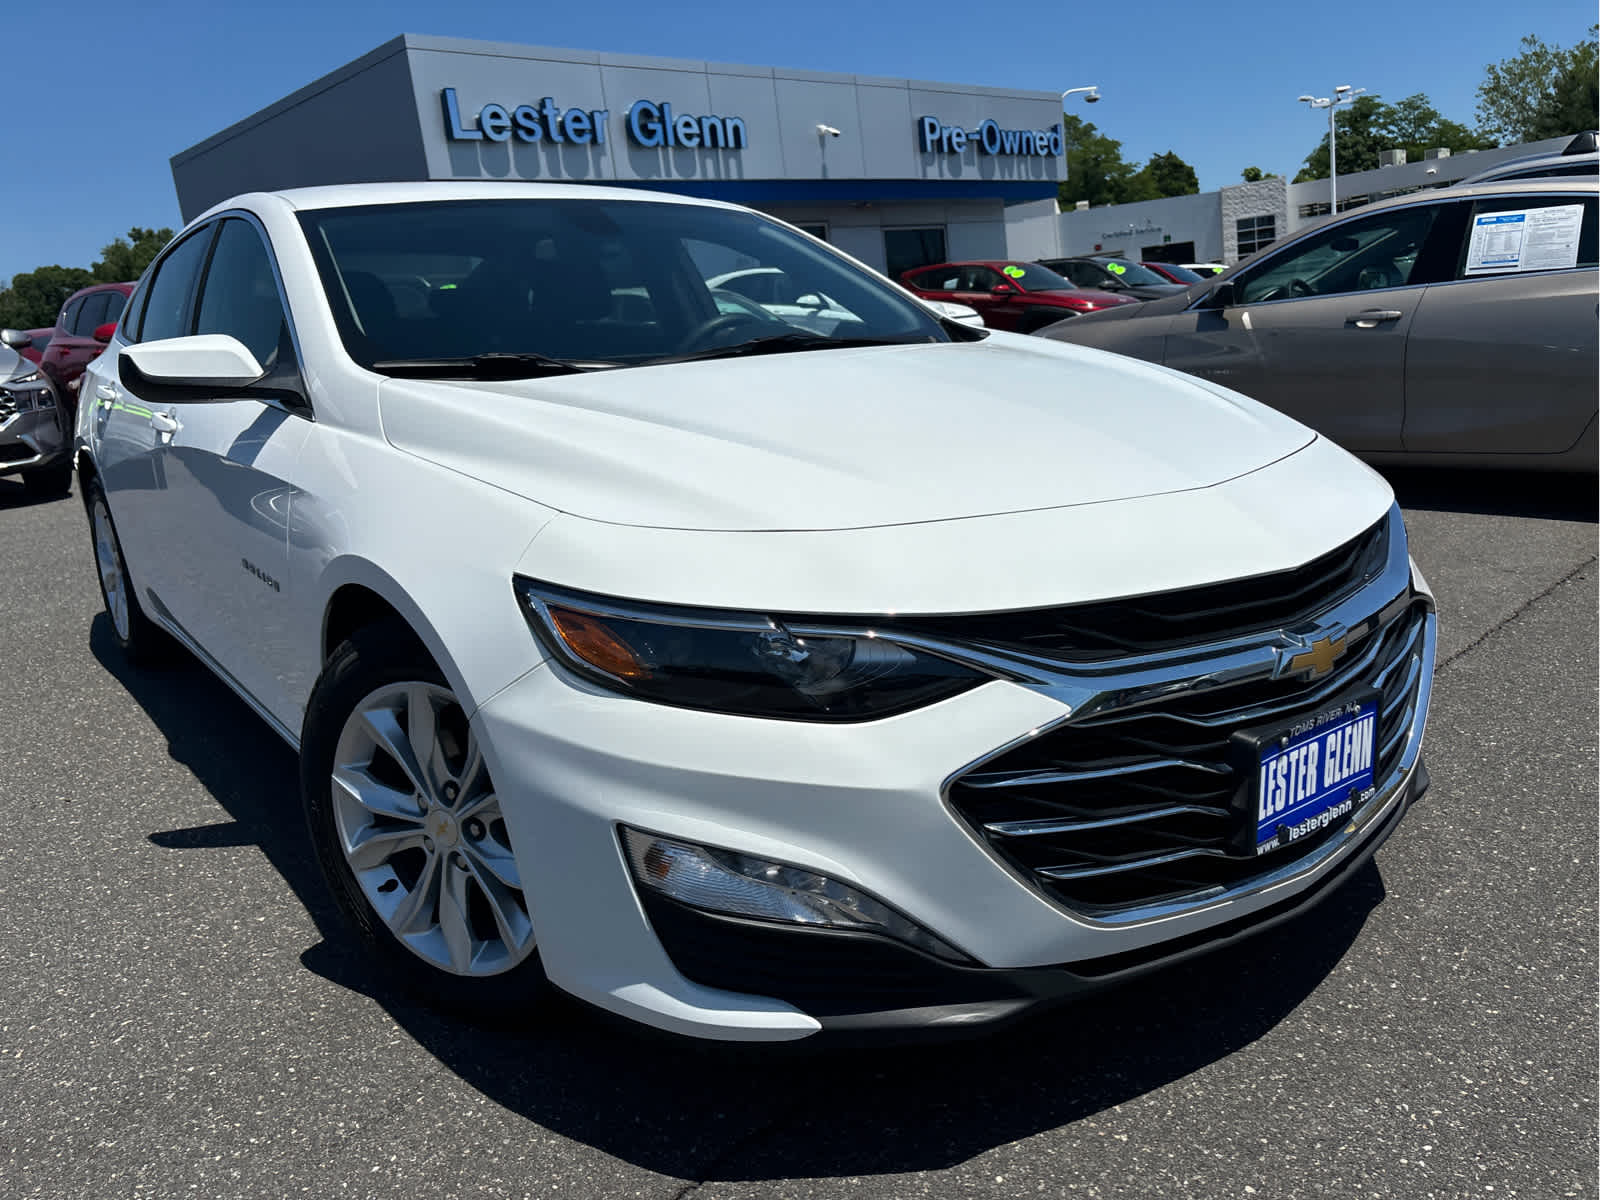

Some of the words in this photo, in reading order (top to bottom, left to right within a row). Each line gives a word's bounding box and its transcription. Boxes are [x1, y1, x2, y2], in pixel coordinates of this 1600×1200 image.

[440, 87, 608, 144] Lester
[627, 99, 747, 149] Glenn
[919, 115, 1064, 156] Pre-Owned
[1289, 719, 1315, 738] TOMS
[1258, 741, 1319, 821] LESTER
[1324, 716, 1374, 788] GLENN
